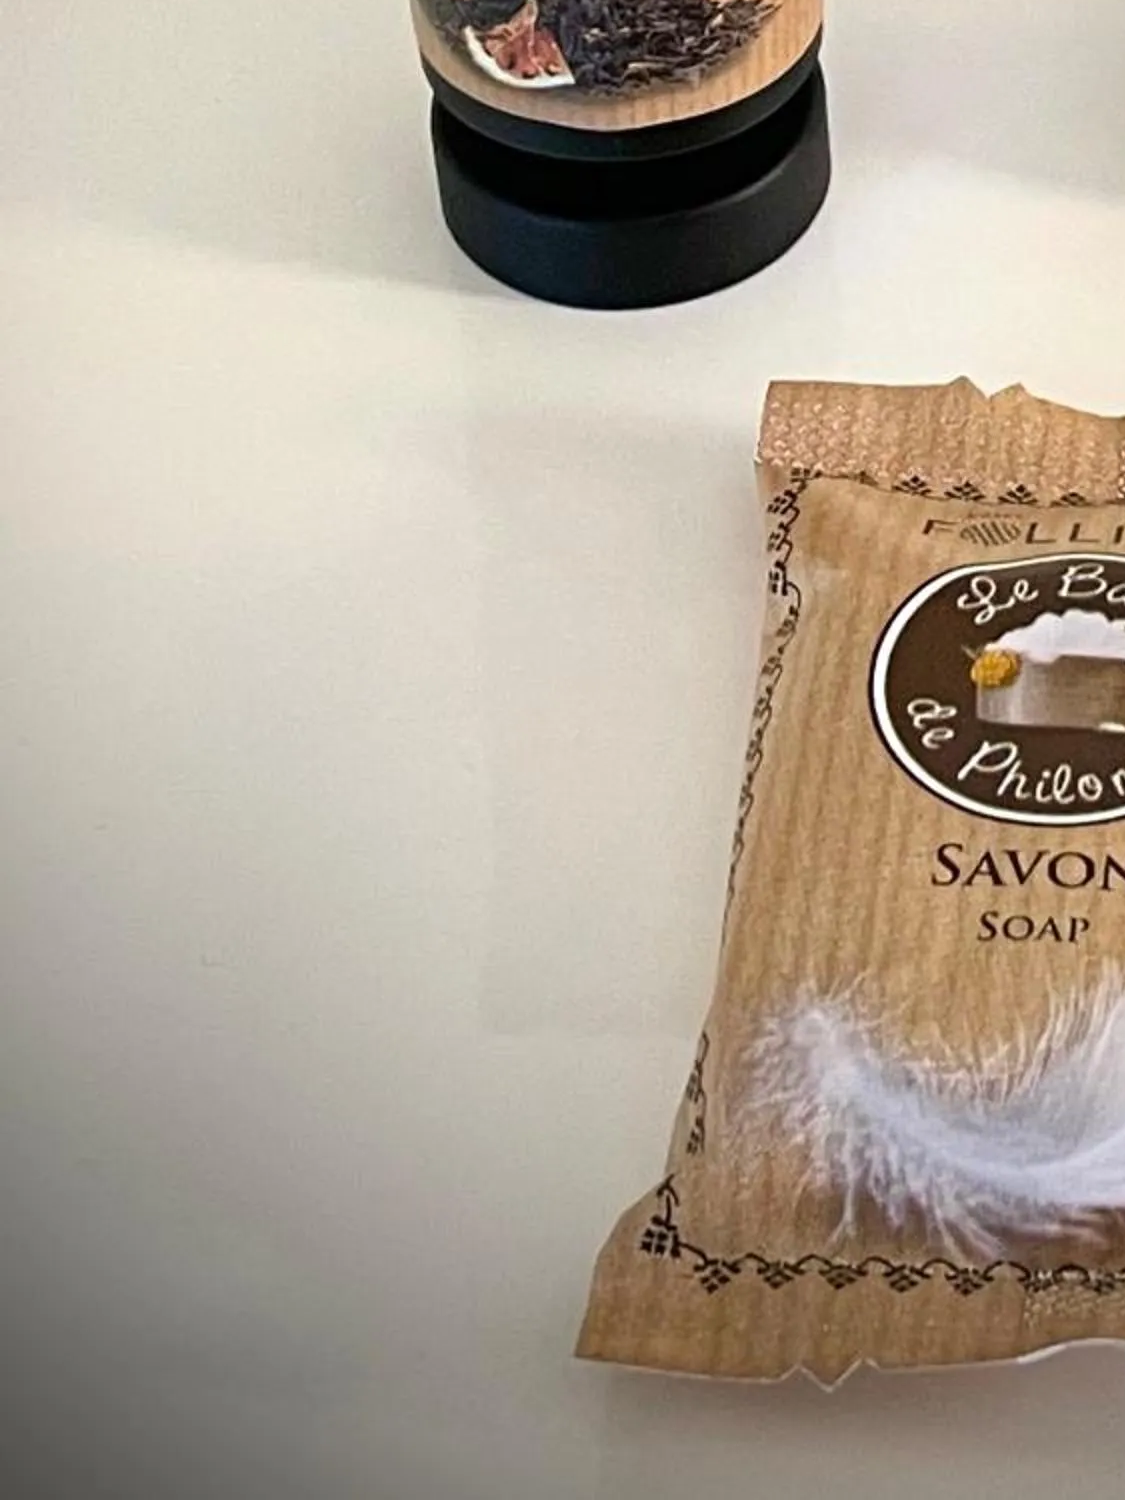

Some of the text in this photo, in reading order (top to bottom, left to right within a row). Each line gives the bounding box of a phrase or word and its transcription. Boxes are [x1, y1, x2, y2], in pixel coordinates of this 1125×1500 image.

[957, 575, 1038, 625] Le
[906, 698, 957, 750] de
[977, 910, 1090, 943] SOAP
